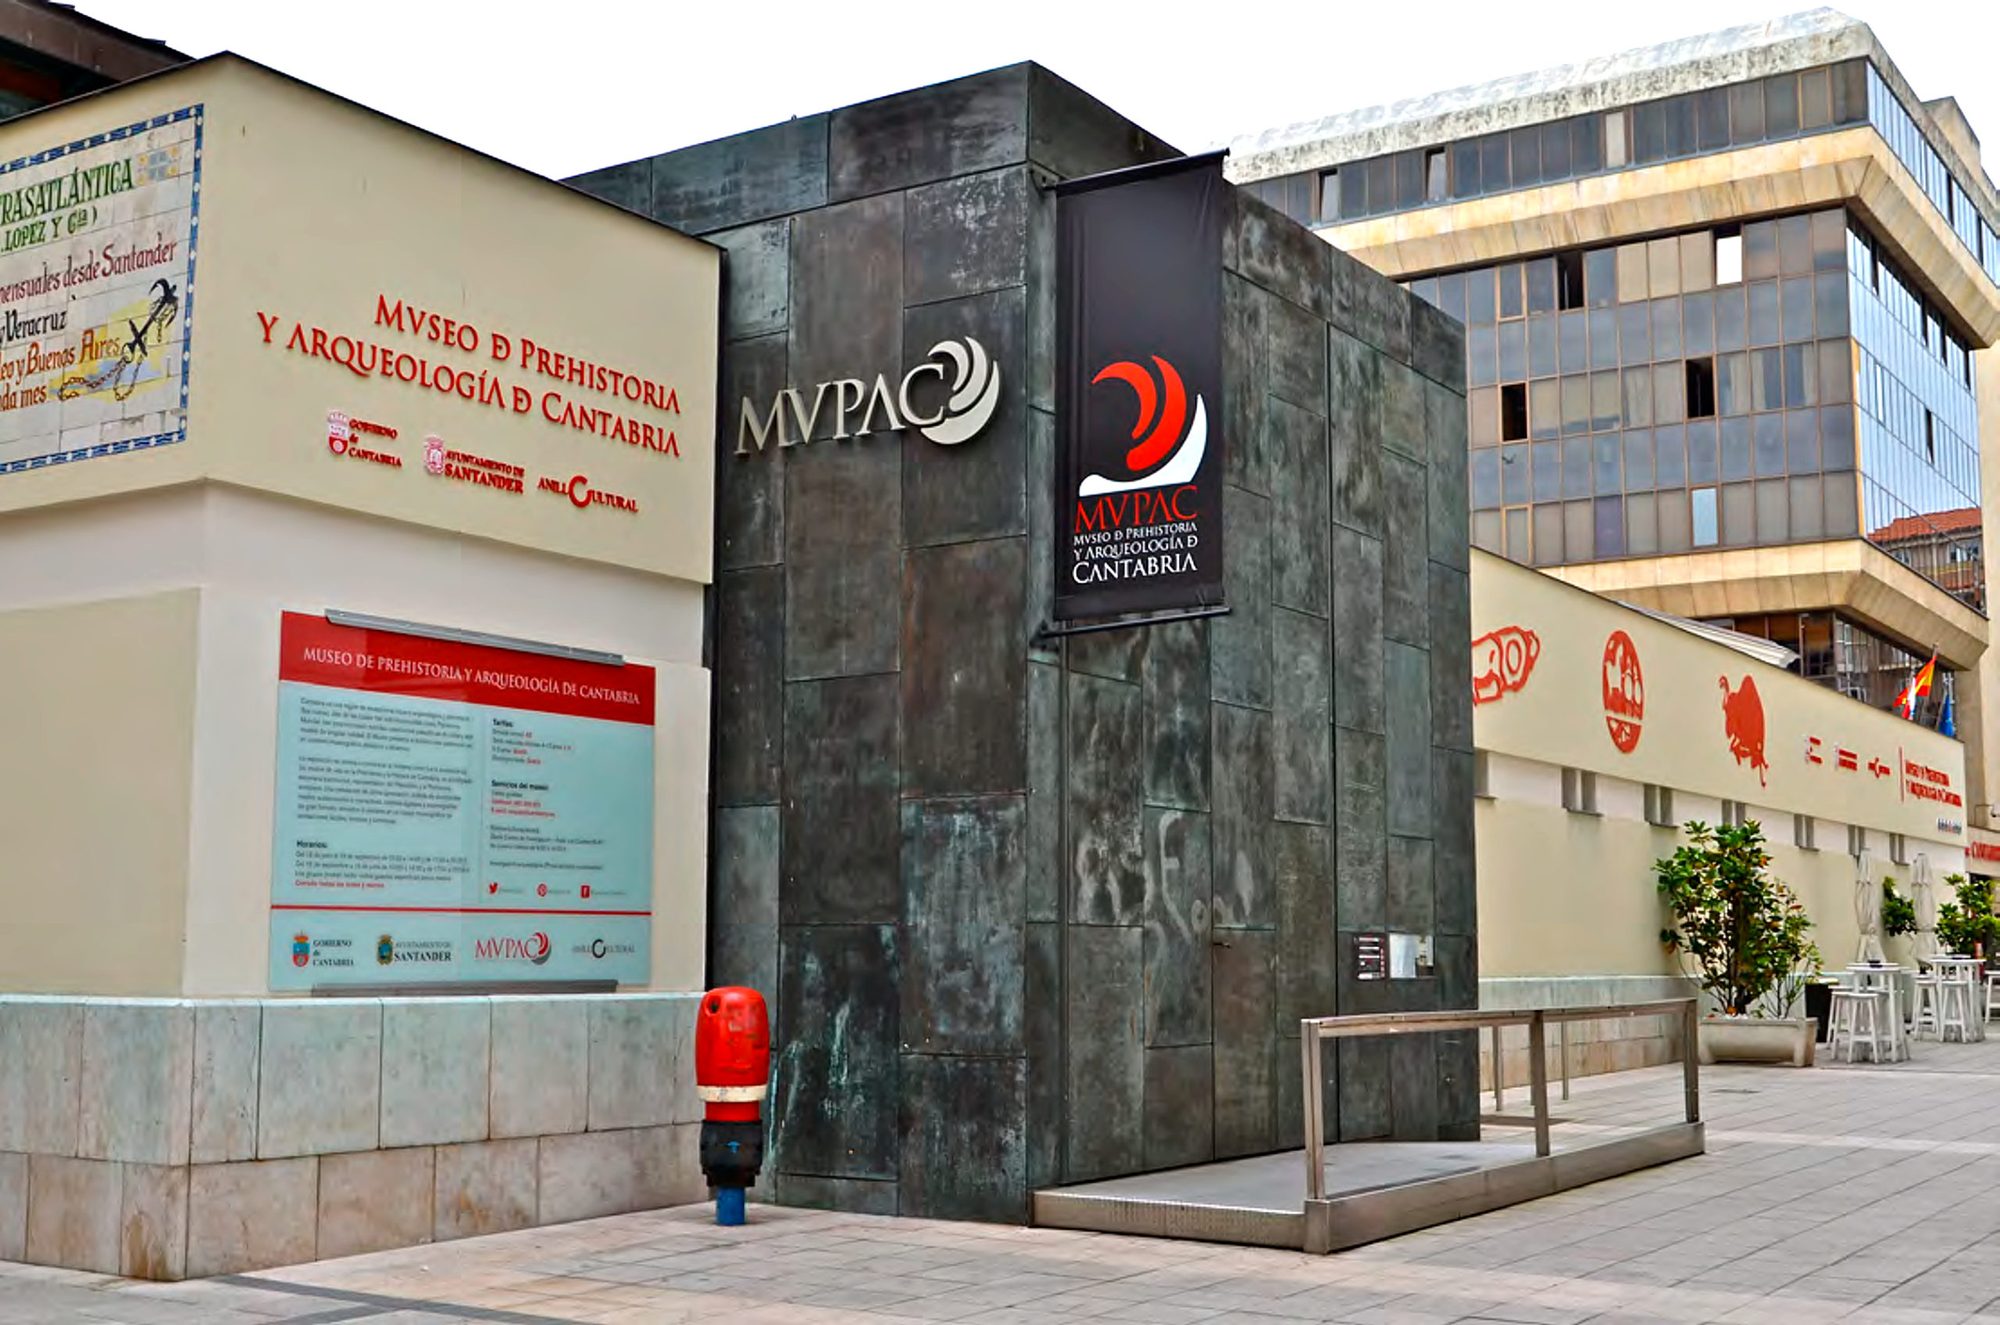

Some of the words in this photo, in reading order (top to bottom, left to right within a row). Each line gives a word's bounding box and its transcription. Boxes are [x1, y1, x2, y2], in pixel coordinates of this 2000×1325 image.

[0, 158, 134, 226] RASATLÁNTICA
[52, 215, 63, 239] Y
[62, 249, 101, 288] desde
[101, 232, 178, 277] Santander
[5, 308, 69, 342] Veracruz
[0, 351, 14, 380] eo
[15, 359, 25, 386] y
[26, 341, 75, 376] Buenos
[80, 328, 120, 364] Aires
[257, 311, 279, 344] Y
[287, 323, 505, 409] ARQUEOLOGÍA
[541, 391, 681, 457] CANTABRIA
[520, 338, 681, 415] PREHISTORIA
[0, 383, 17, 411] da
[20, 385, 47, 406] mes
[734, 363, 944, 455] MVPAC
[444, 463, 524, 495] SANTANDER
[1075, 485, 1198, 534] MVPAC
[1074, 549, 1083, 561] Y
[1085, 534, 1184, 560] ARQUEOLOGÍA
[1126, 521, 1197, 540] PREHISTORIA
[1072, 553, 1197, 584] CANTABRIA
[303, 647, 352, 666] MUSEO
[356, 653, 374, 669] DE
[378, 656, 462, 681] PREHISTORIA
[463, 668, 472, 682] Y
[475, 670, 559, 694] ARQUEOLOGÍA
[563, 681, 576, 697] DE
[580, 684, 640, 705] CANTABRIA
[394, 951, 452, 962] SANTANDER
[475, 937, 538, 959] MVPAC
